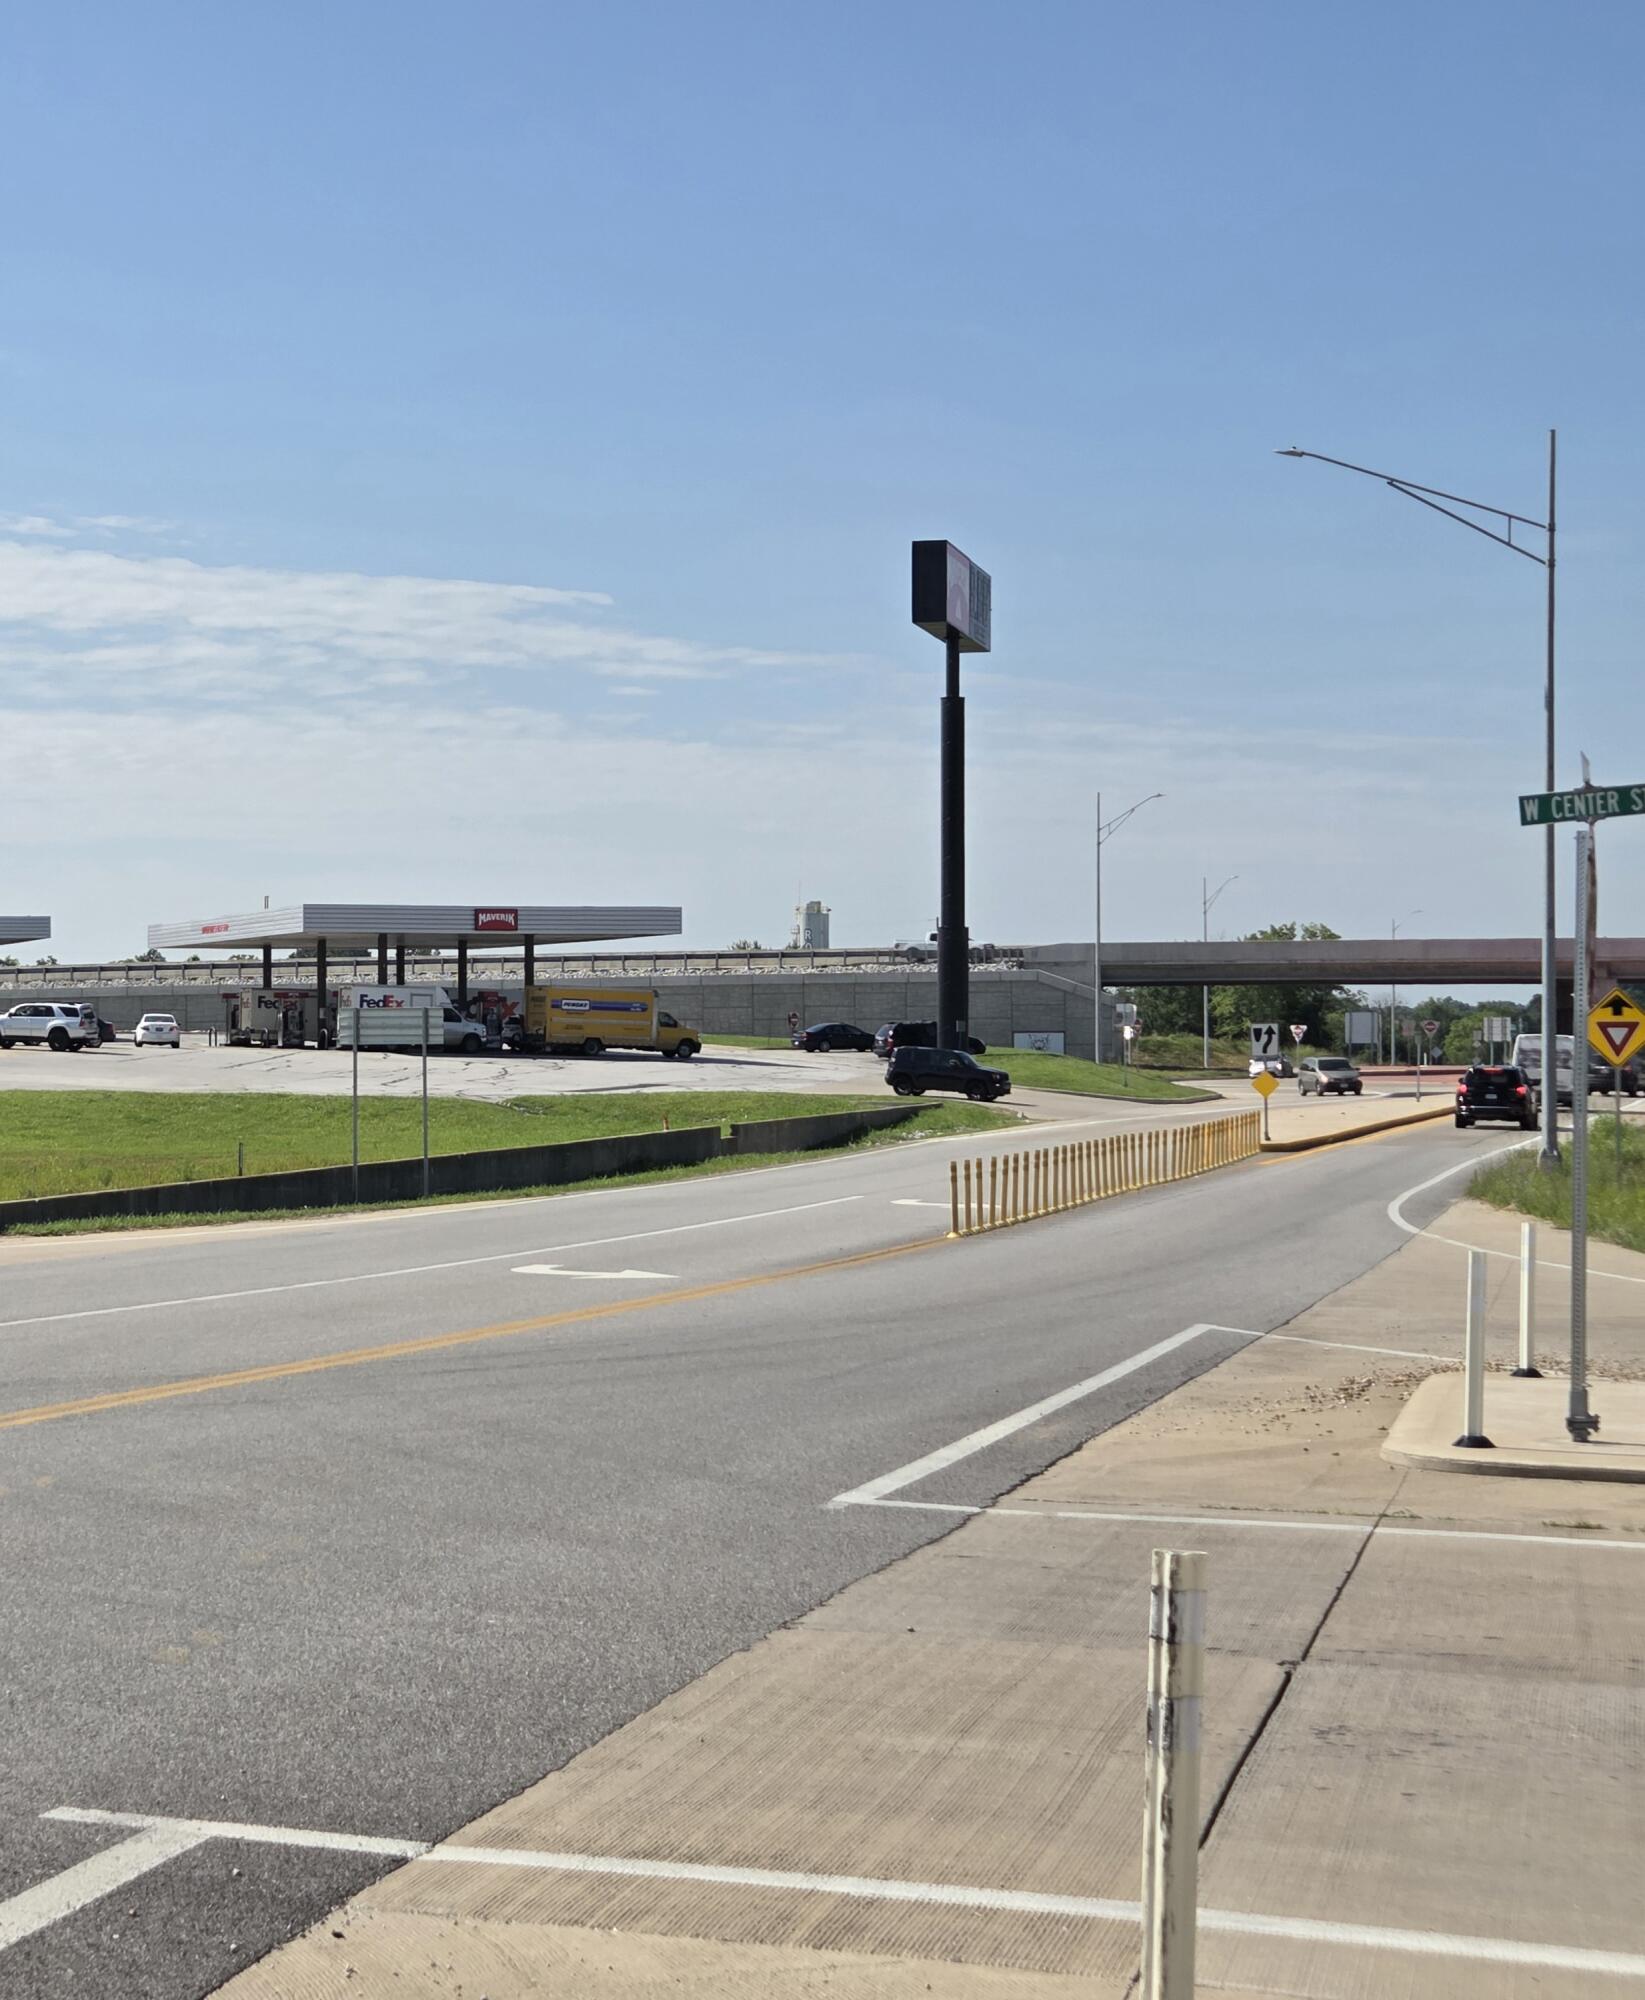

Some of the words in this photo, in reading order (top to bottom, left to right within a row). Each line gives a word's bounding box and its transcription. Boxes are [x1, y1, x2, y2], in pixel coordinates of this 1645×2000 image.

[1523, 799, 1539, 821] W
[1551, 791, 1620, 819] CENTER
[478, 913, 515, 926] MAVERIK
[360, 994, 405, 1008] FedEx
